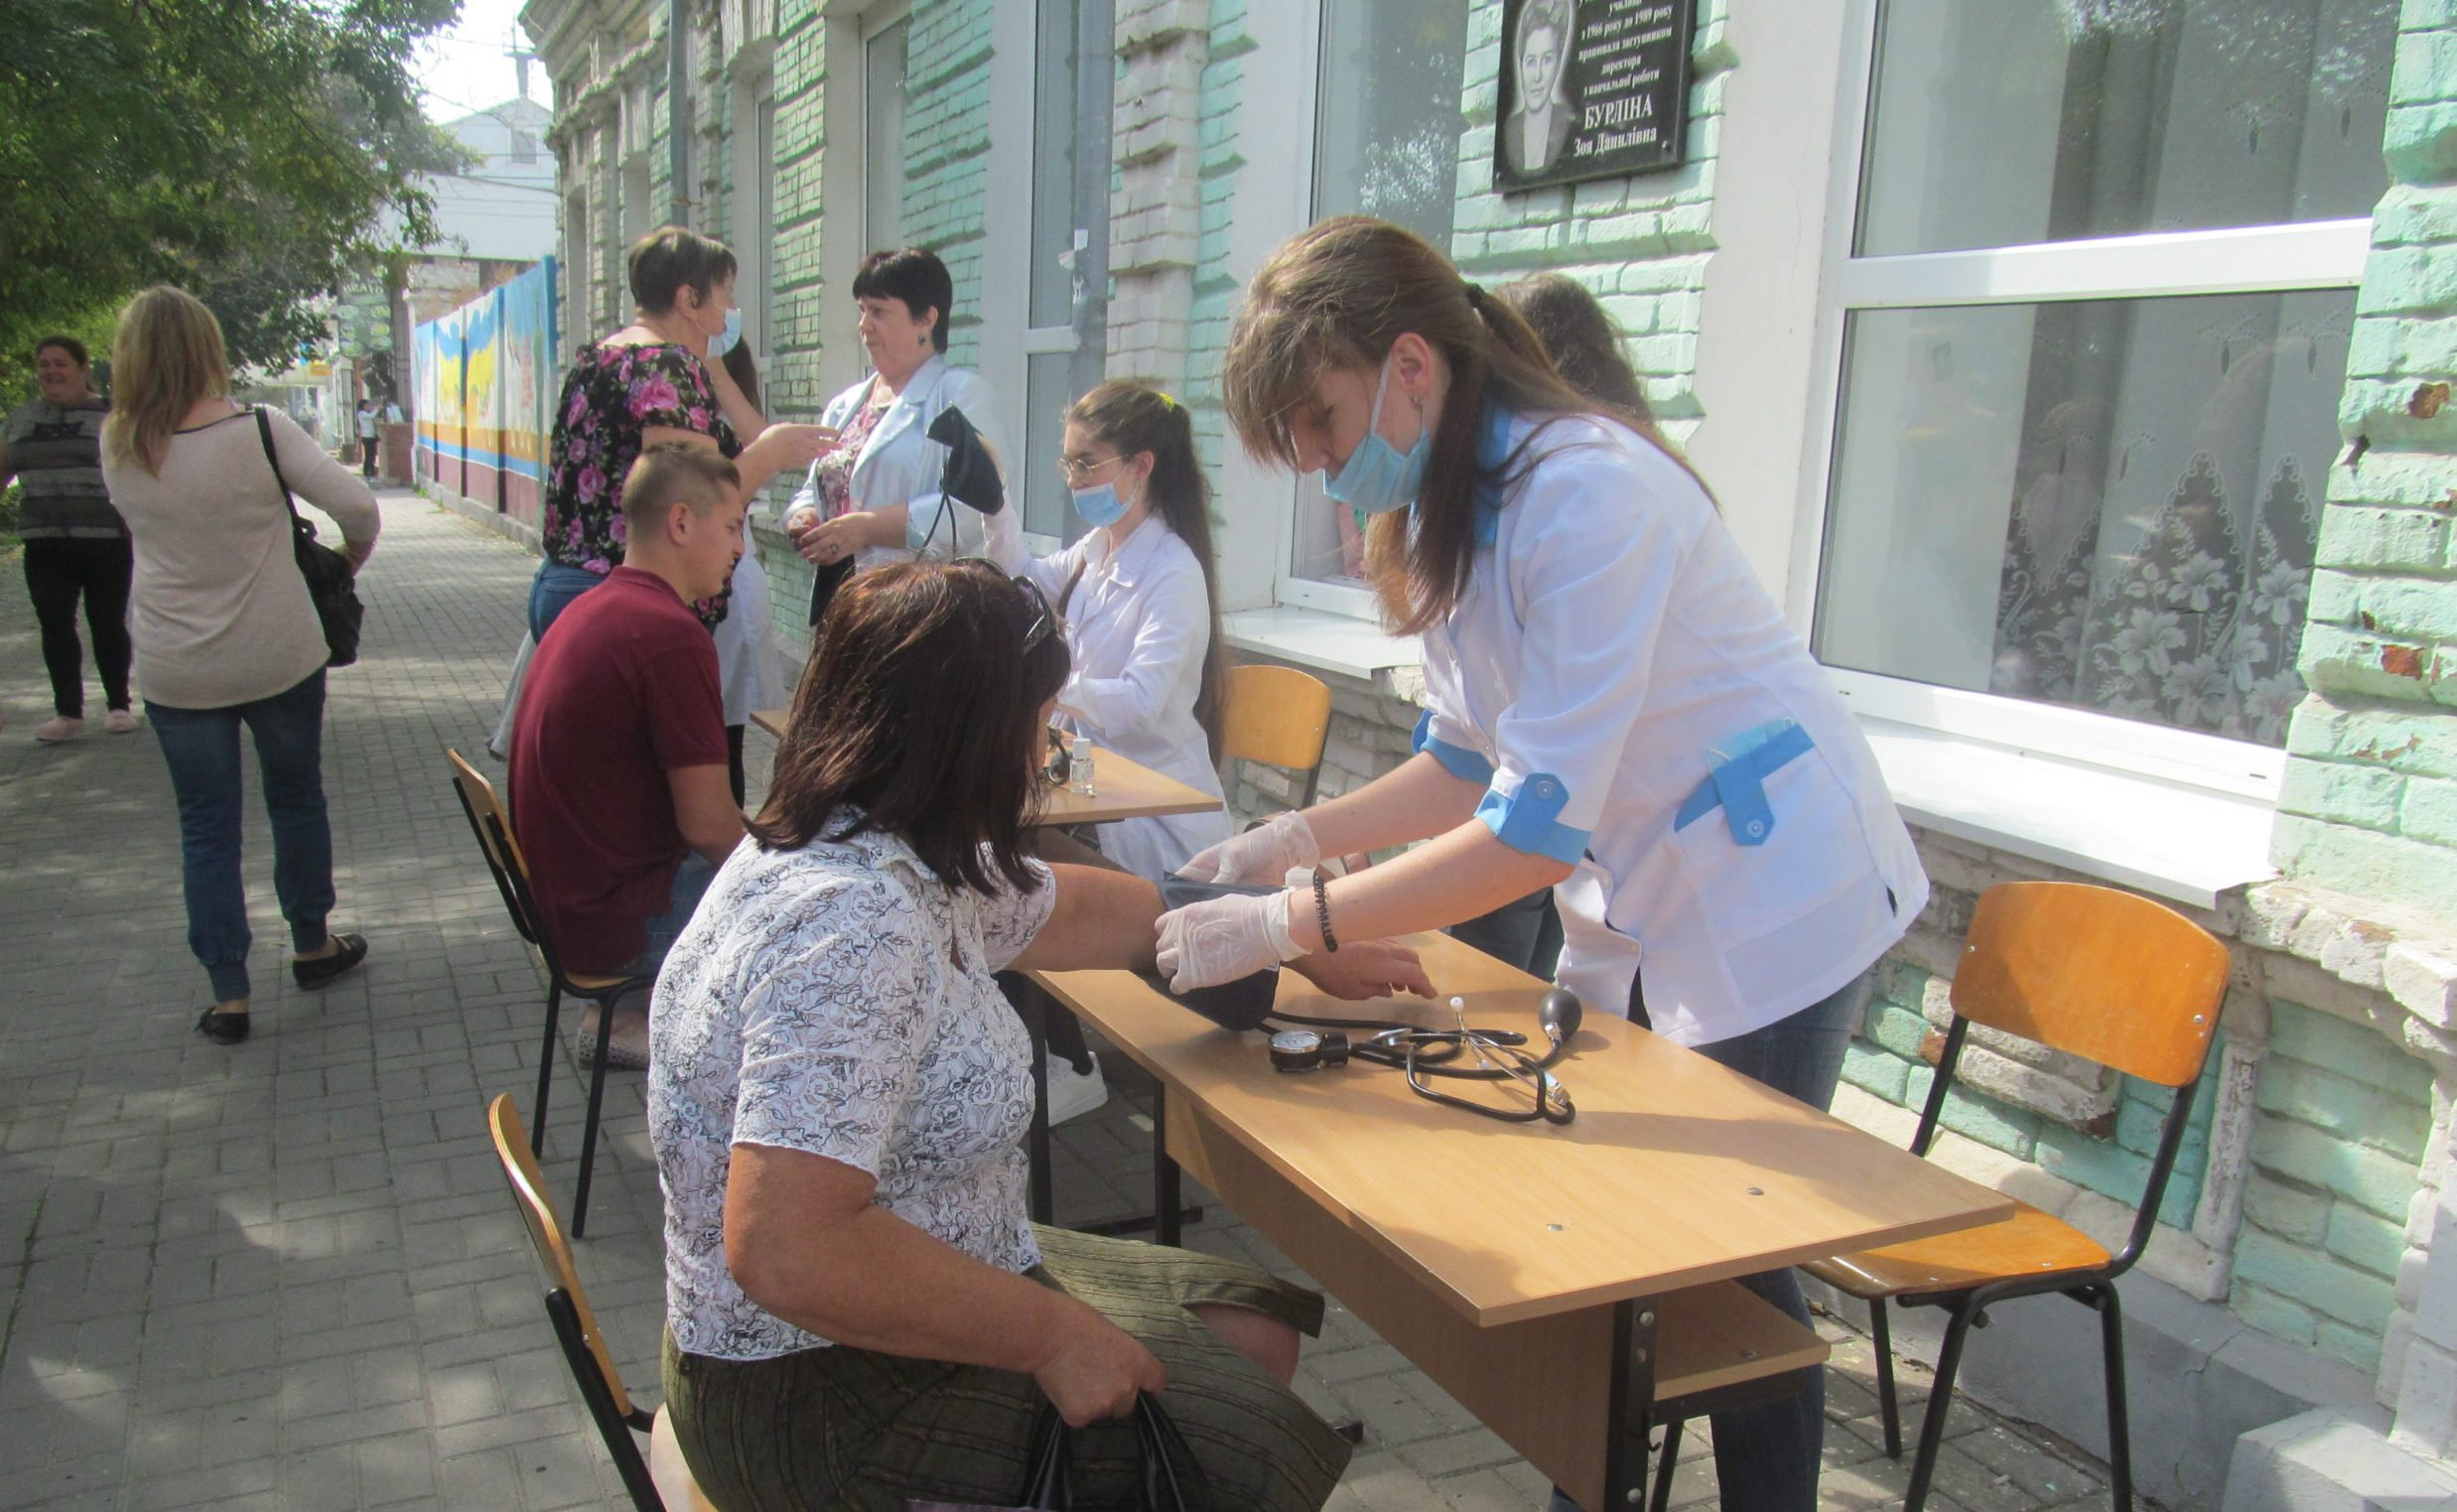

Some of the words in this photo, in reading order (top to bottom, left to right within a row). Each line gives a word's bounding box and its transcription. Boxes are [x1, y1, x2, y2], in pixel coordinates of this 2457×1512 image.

[1604, 20, 1622, 38] року
[1653, 4, 1674, 24] року
[1600, 55, 1642, 75] директора
[1631, 67, 1661, 89] роботи
[1584, 92, 1653, 130] БУРЛІНА
[1573, 137, 1593, 158] Зоя
[1593, 126, 1657, 157] Данилівна
